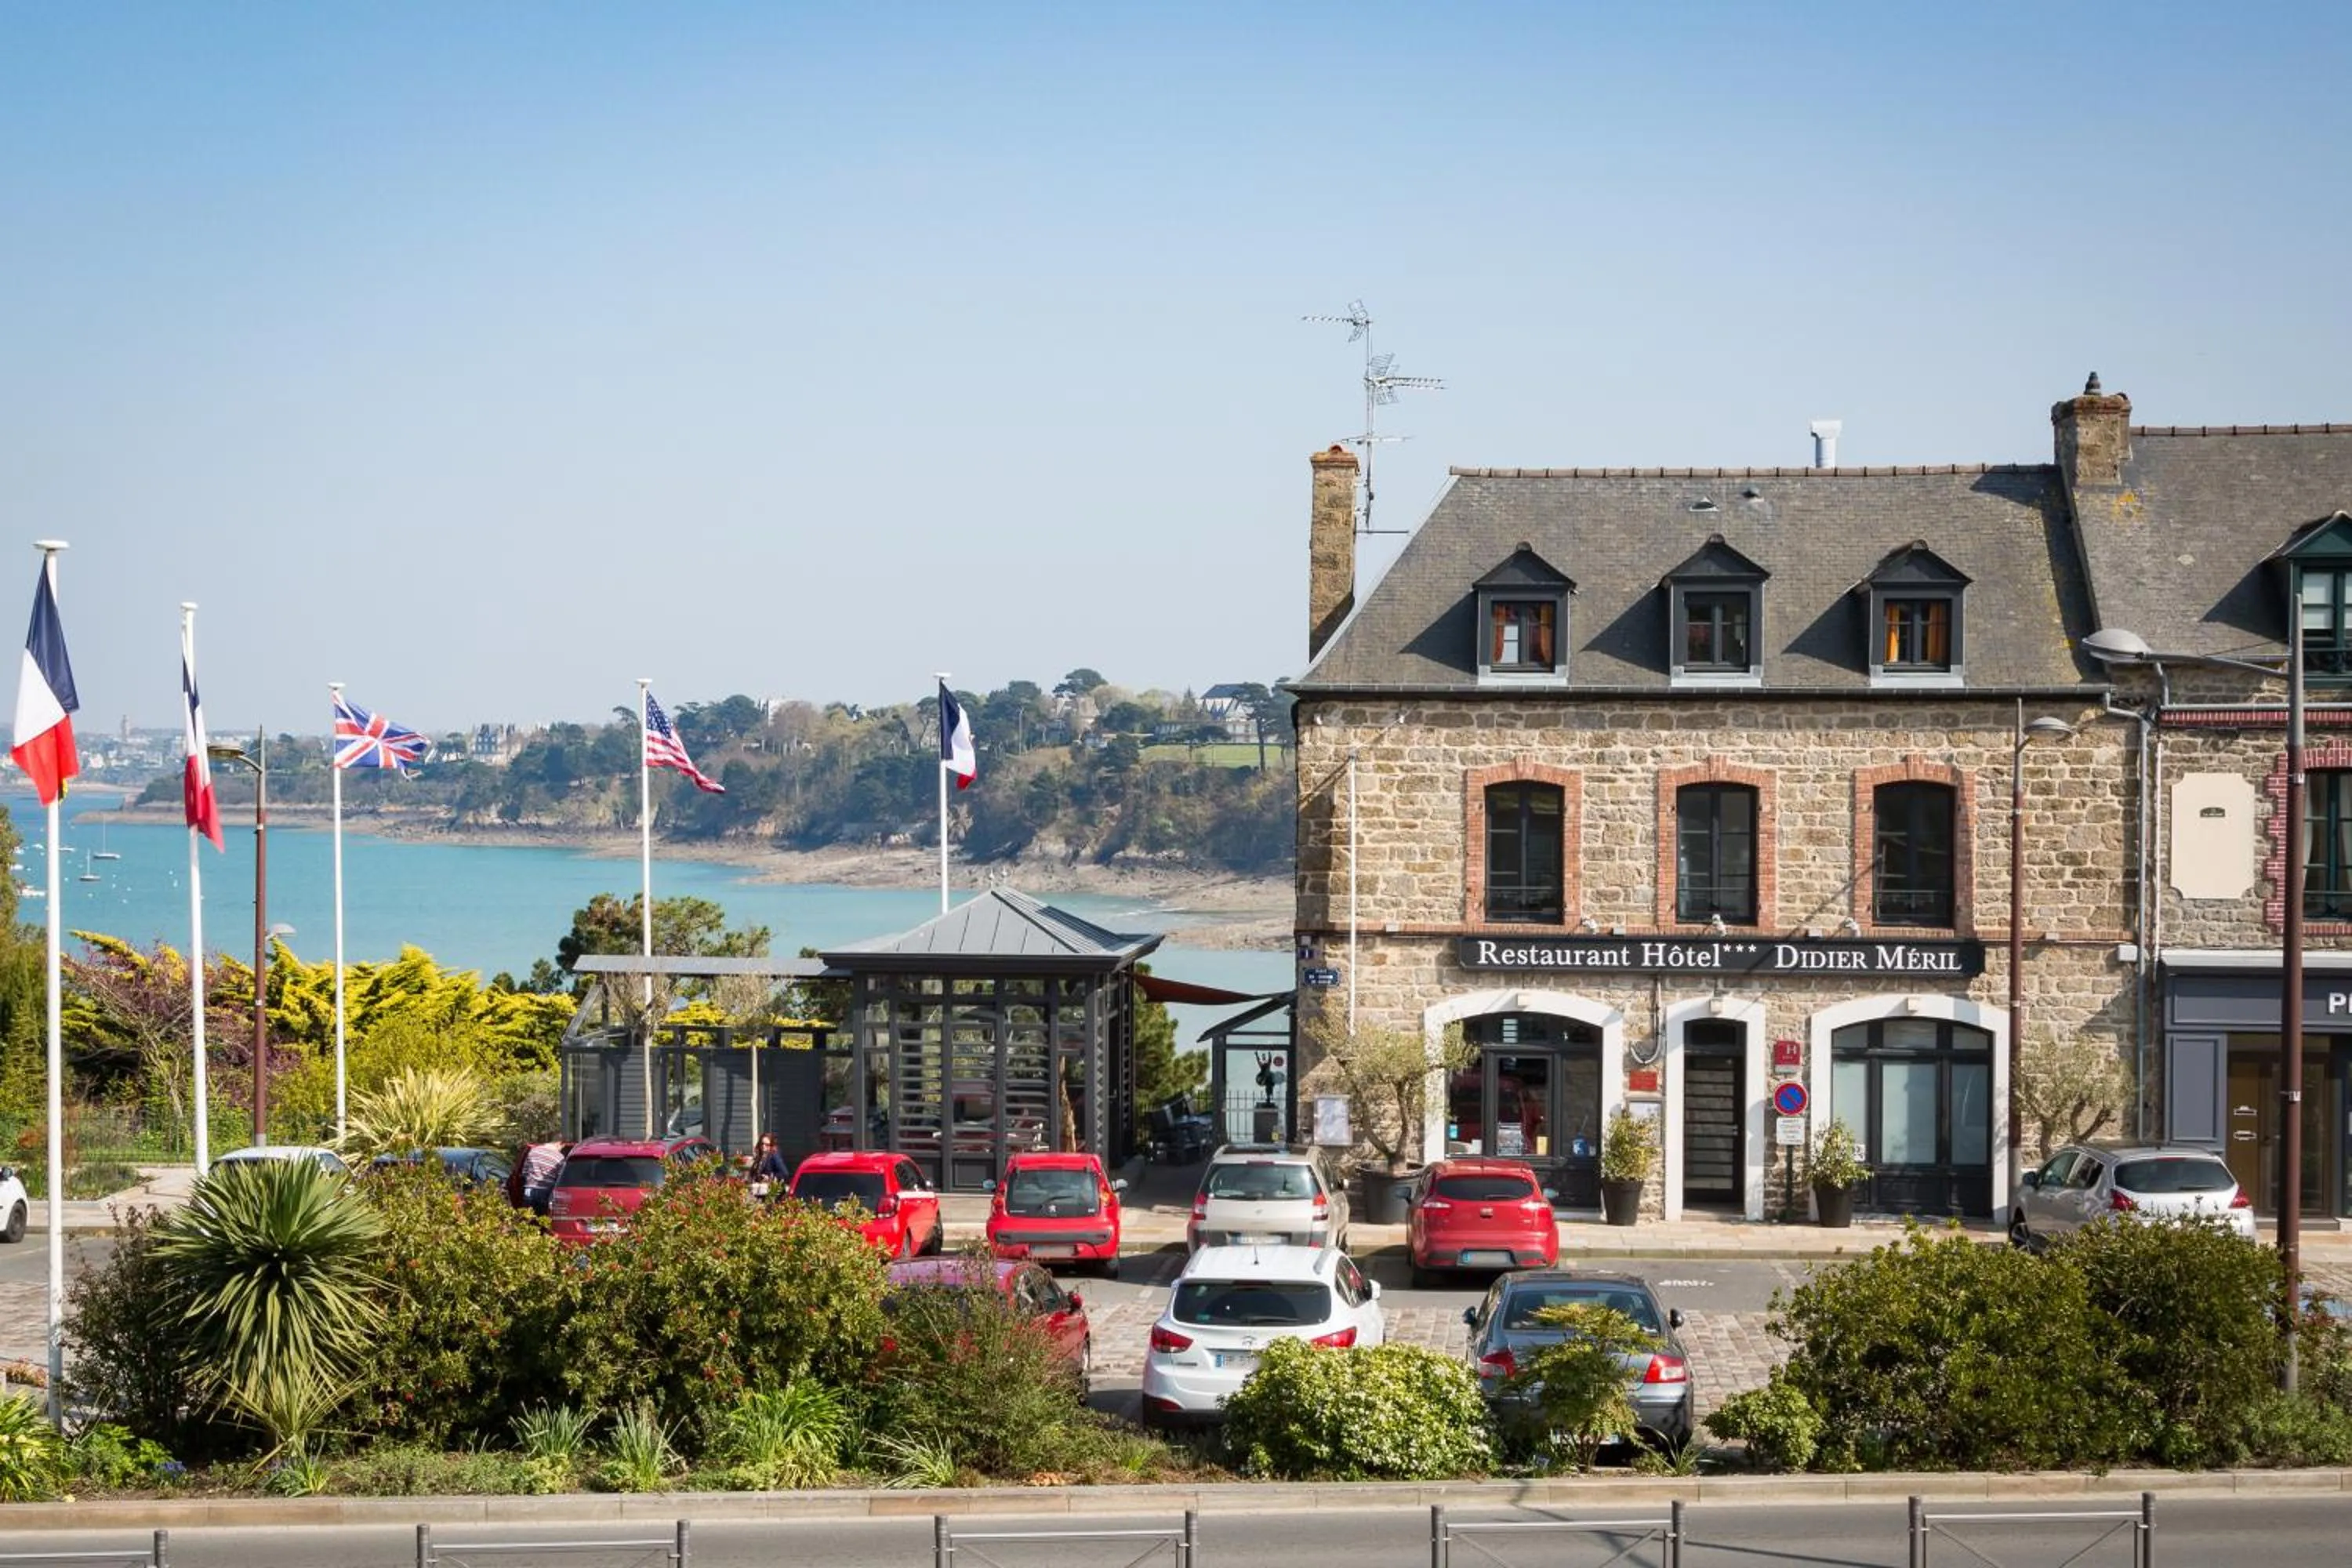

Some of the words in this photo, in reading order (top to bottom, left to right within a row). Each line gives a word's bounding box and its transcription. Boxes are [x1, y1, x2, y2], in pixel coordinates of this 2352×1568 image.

[1477, 940, 1631, 967] Restaurant
[1774, 944, 1867, 969] DIDIER
[1875, 945, 1962, 971] MÉRIL
[1786, 1044, 1797, 1055] H
